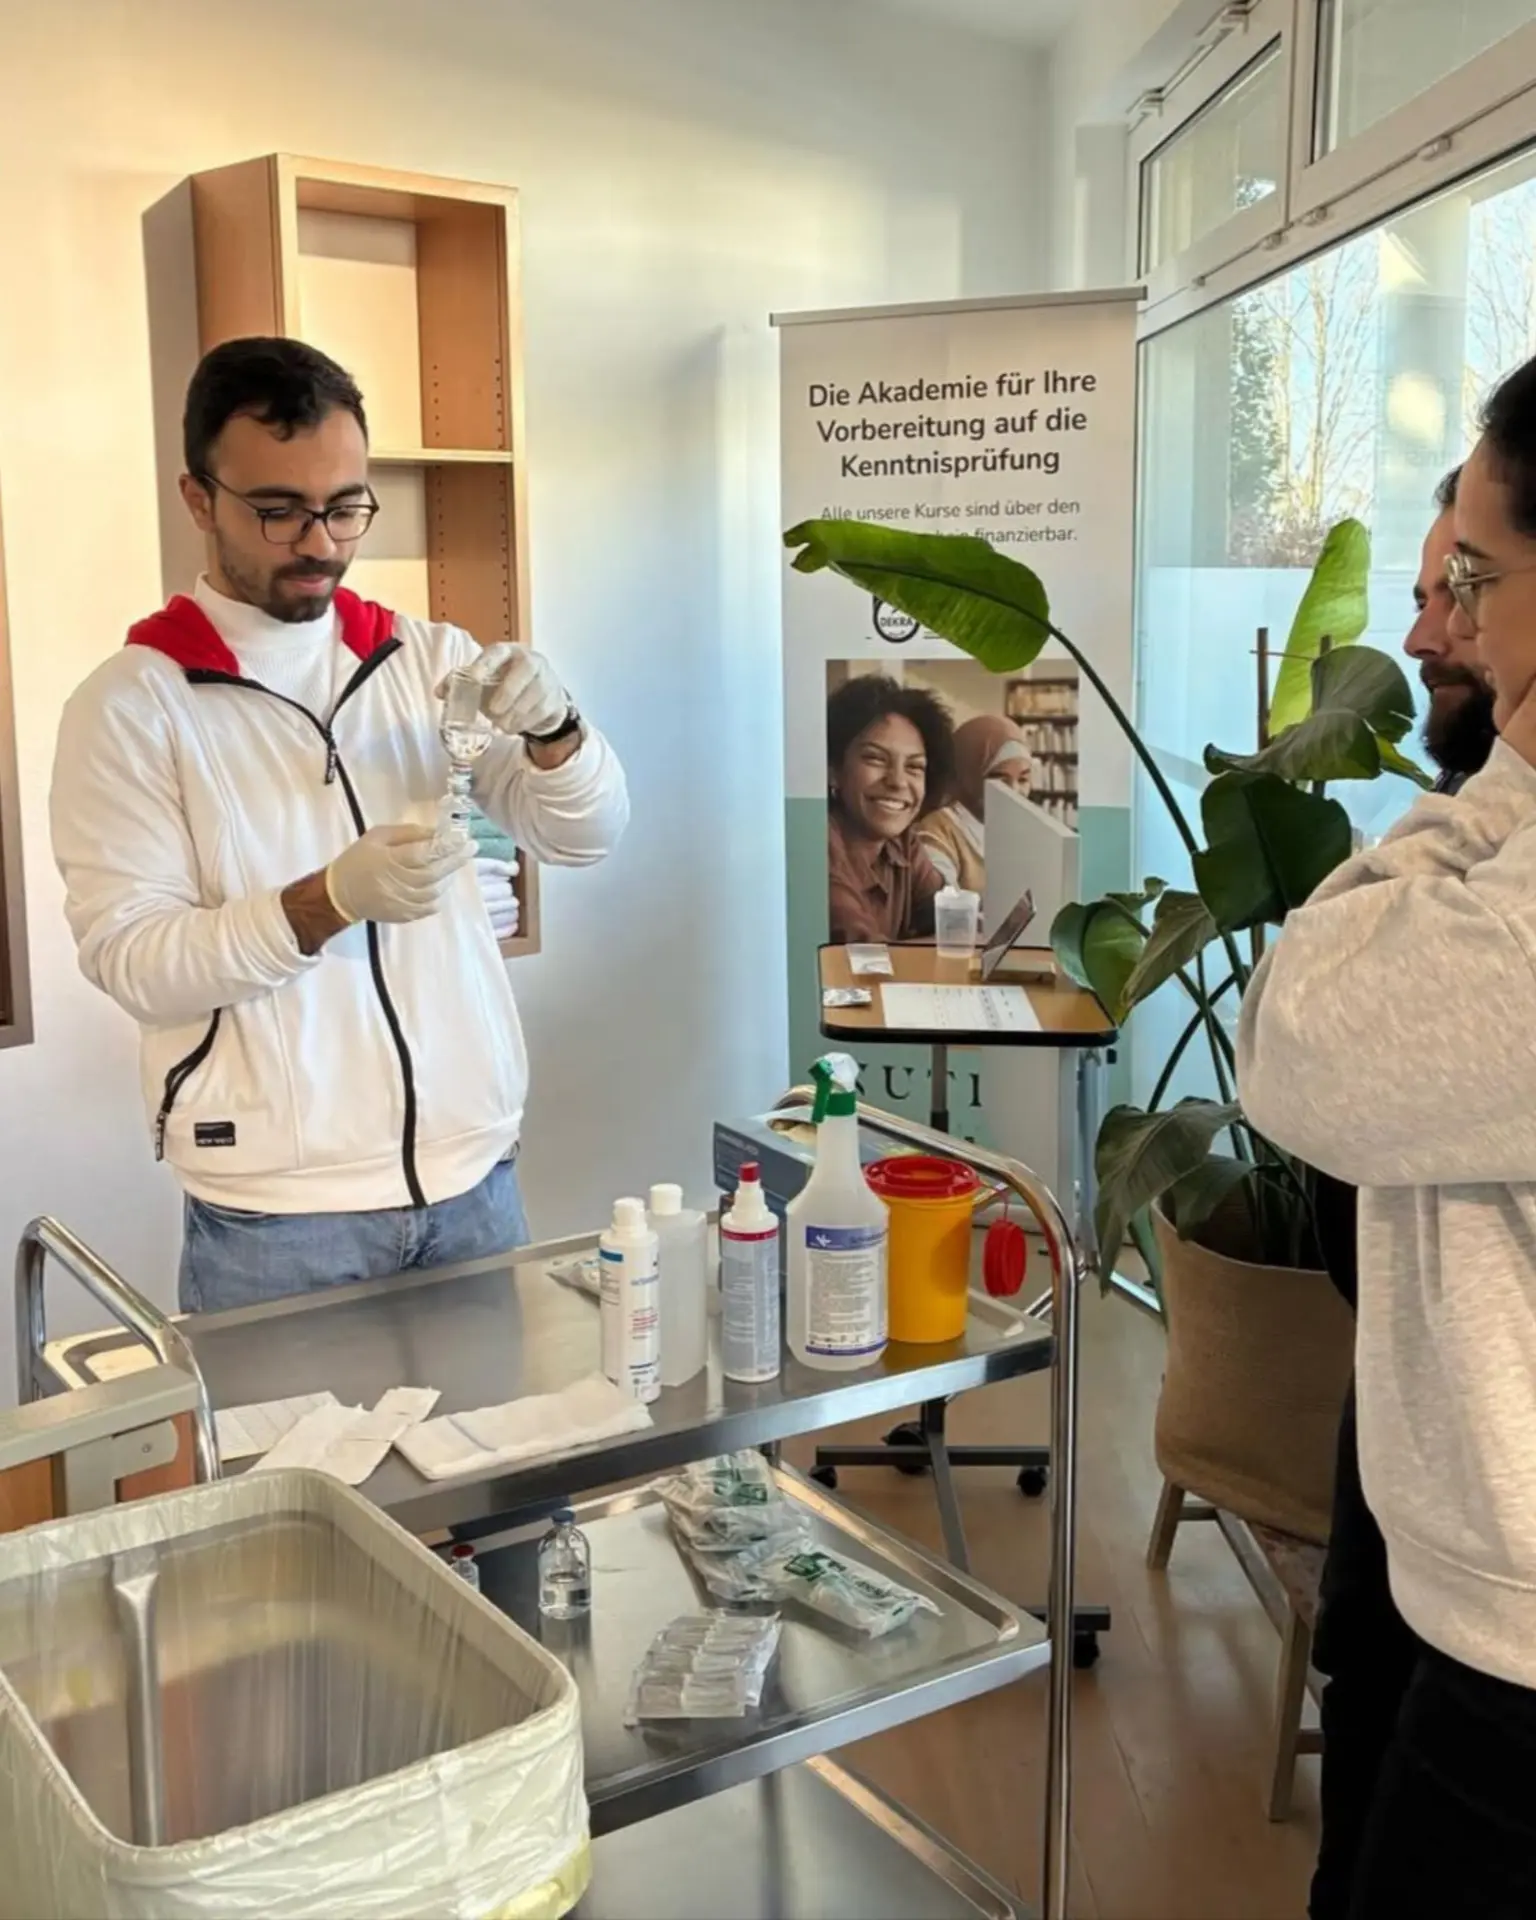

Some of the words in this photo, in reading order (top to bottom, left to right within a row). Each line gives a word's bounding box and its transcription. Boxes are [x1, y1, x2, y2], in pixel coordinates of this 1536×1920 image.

[808, 383, 851, 408] Die
[857, 374, 989, 405] Akademie
[995, 370, 1035, 397] für
[1042, 369, 1097, 395] Ihre
[816, 415, 986, 443] Vorbereitung
[993, 409, 1038, 434] auf
[1045, 406, 1088, 432] die
[840, 447, 1060, 479] Kenntnisprüfung
[821, 505, 852, 520] Alle
[856, 508, 910, 519] unsere
[914, 503, 961, 518] Kurse
[965, 501, 1000, 516] sind
[1005, 499, 1043, 516] über
[1047, 498, 1081, 514] den
[974, 525, 1079, 543] finanzierbar.
[880, 617, 913, 627] DEKRA
